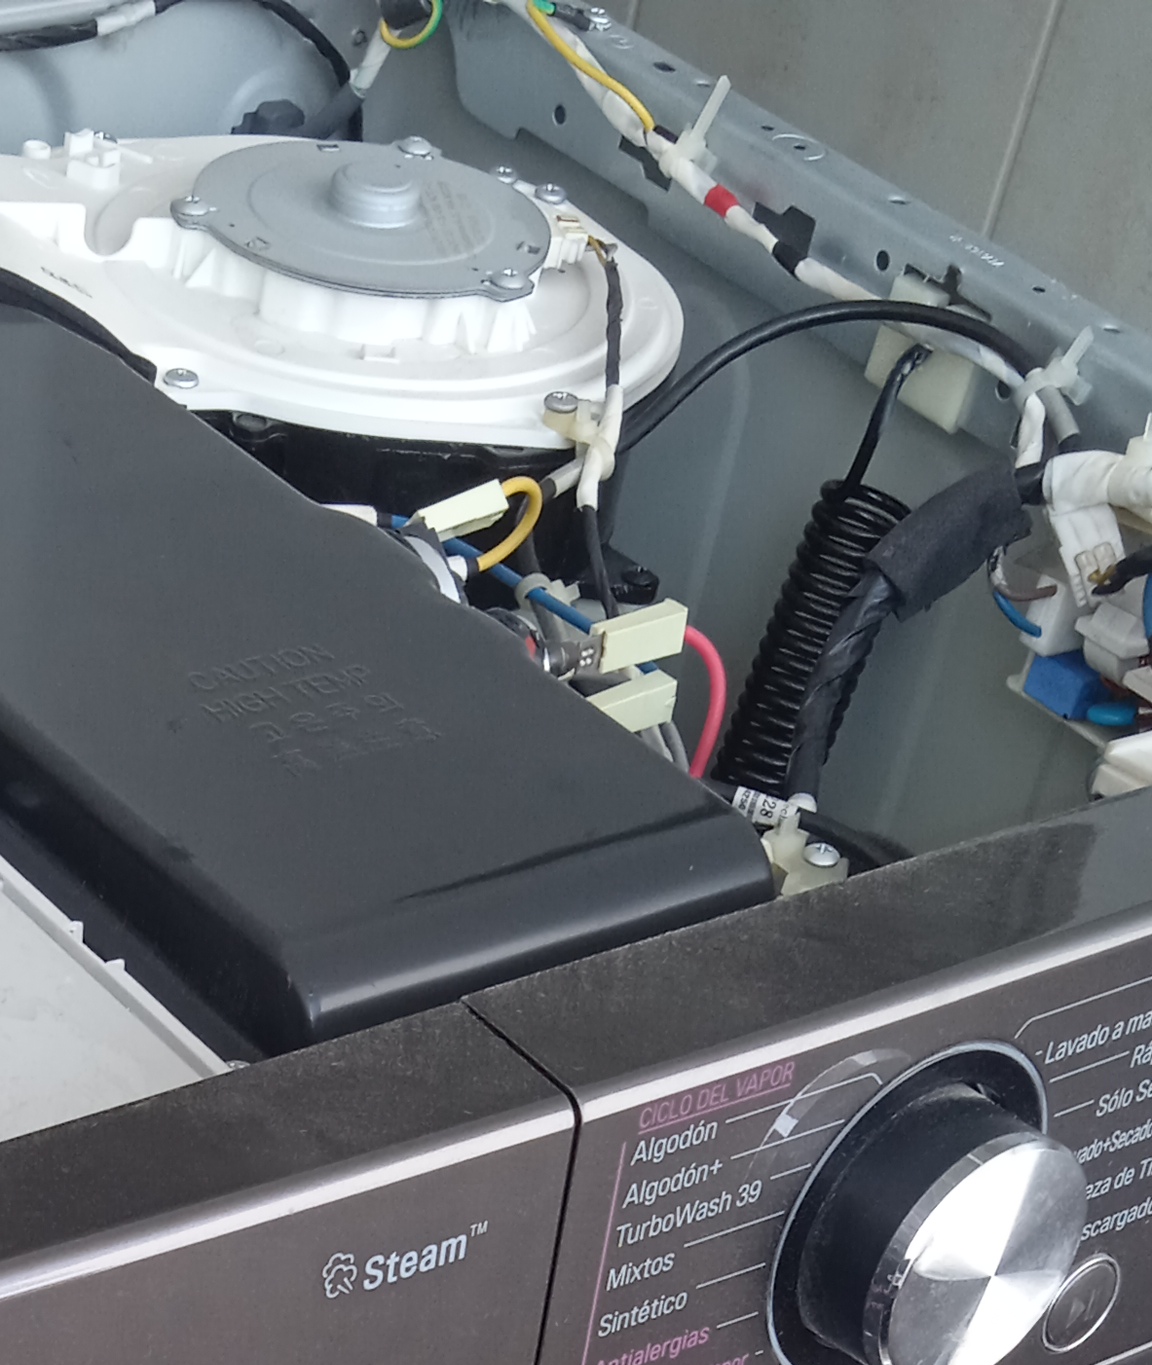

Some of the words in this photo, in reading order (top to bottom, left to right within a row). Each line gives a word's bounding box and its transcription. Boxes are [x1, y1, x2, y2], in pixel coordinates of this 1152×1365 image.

[188, 643, 335, 690] CAUTION
[201, 687, 291, 722] HIGH
[1044, 1023, 1110, 1065] Lavado
[1111, 1020, 1125, 1041] a
[639, 1094, 693, 1130] CICLO
[697, 1084, 729, 1110] DEL
[736, 1061, 796, 1097] VAPOR
[1096, 1087, 1134, 1117] Sólo
[630, 1119, 718, 1166] Algodón
[622, 1159, 723, 1209] Algodón+
[1113, 1166, 1136, 1189] de
[616, 1190, 732, 1247] TurboWash
[736, 1180, 762, 1208] 39
[606, 1252, 676, 1291] Mixtos
[598, 1290, 688, 1338] Sintético
